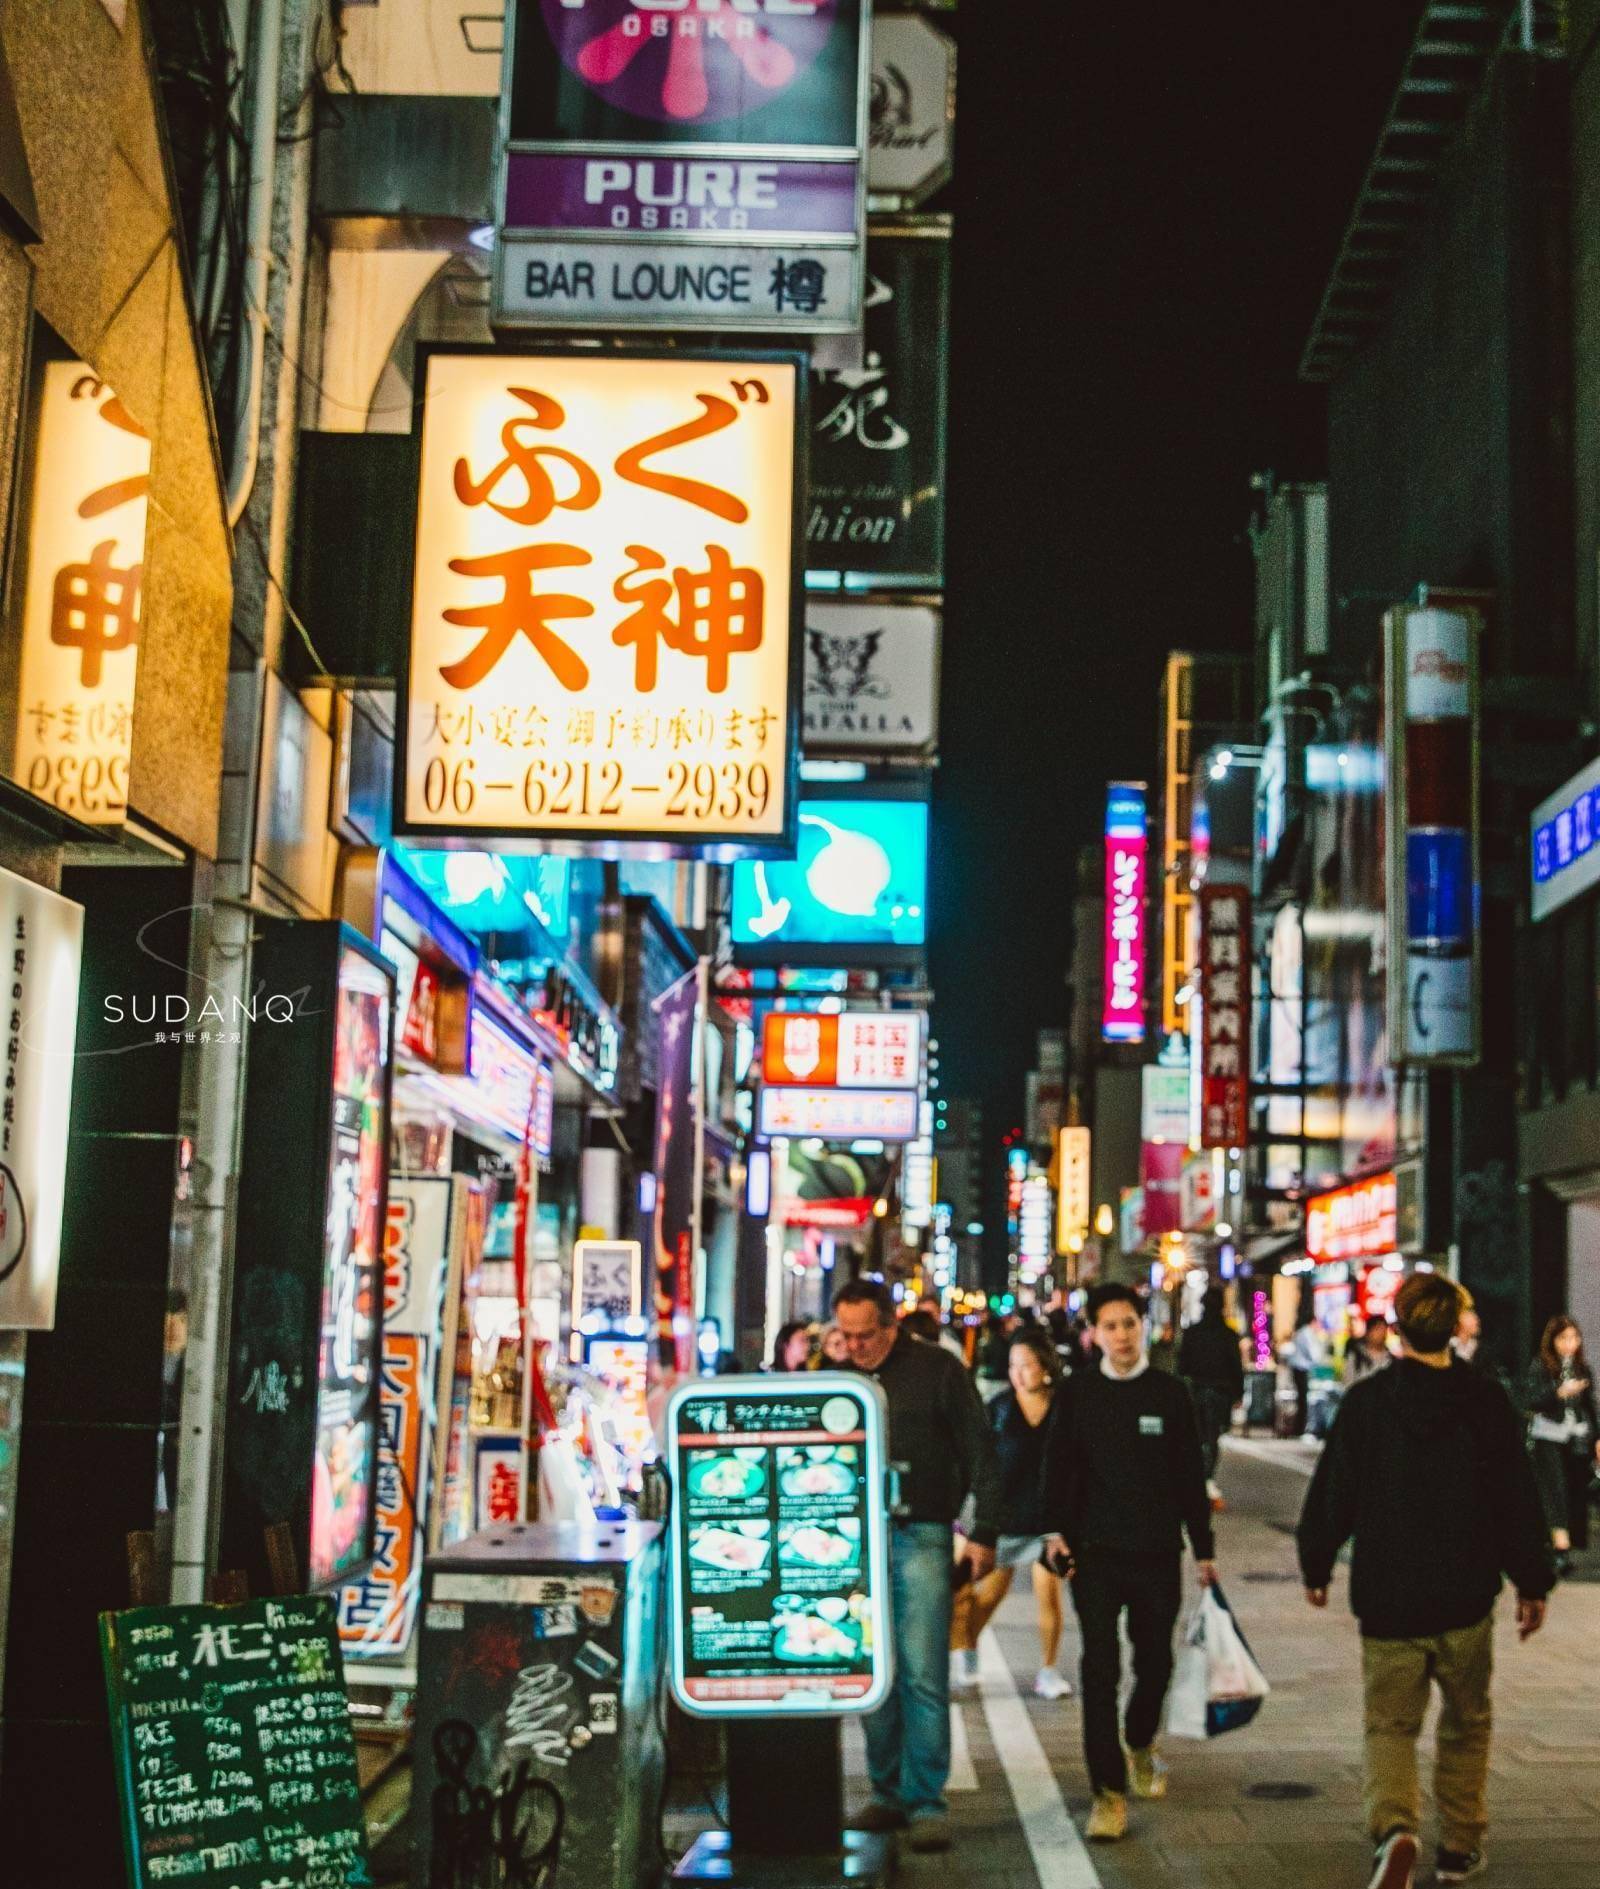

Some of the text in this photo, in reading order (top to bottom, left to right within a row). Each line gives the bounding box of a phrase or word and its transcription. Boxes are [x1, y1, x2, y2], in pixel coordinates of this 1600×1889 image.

[622, 14, 756, 37] OSAKA
[585, 161, 778, 208] PURE
[612, 207, 748, 230] OSAKA
[526, 261, 595, 300] BAR
[613, 264, 751, 302] LOUNGE
[454, 380, 769, 525] ふぐ
[438, 542, 765, 693] 天神
[424, 757, 770, 820] 06-6212-2939
[191, 1623, 271, 1667] オモニ
